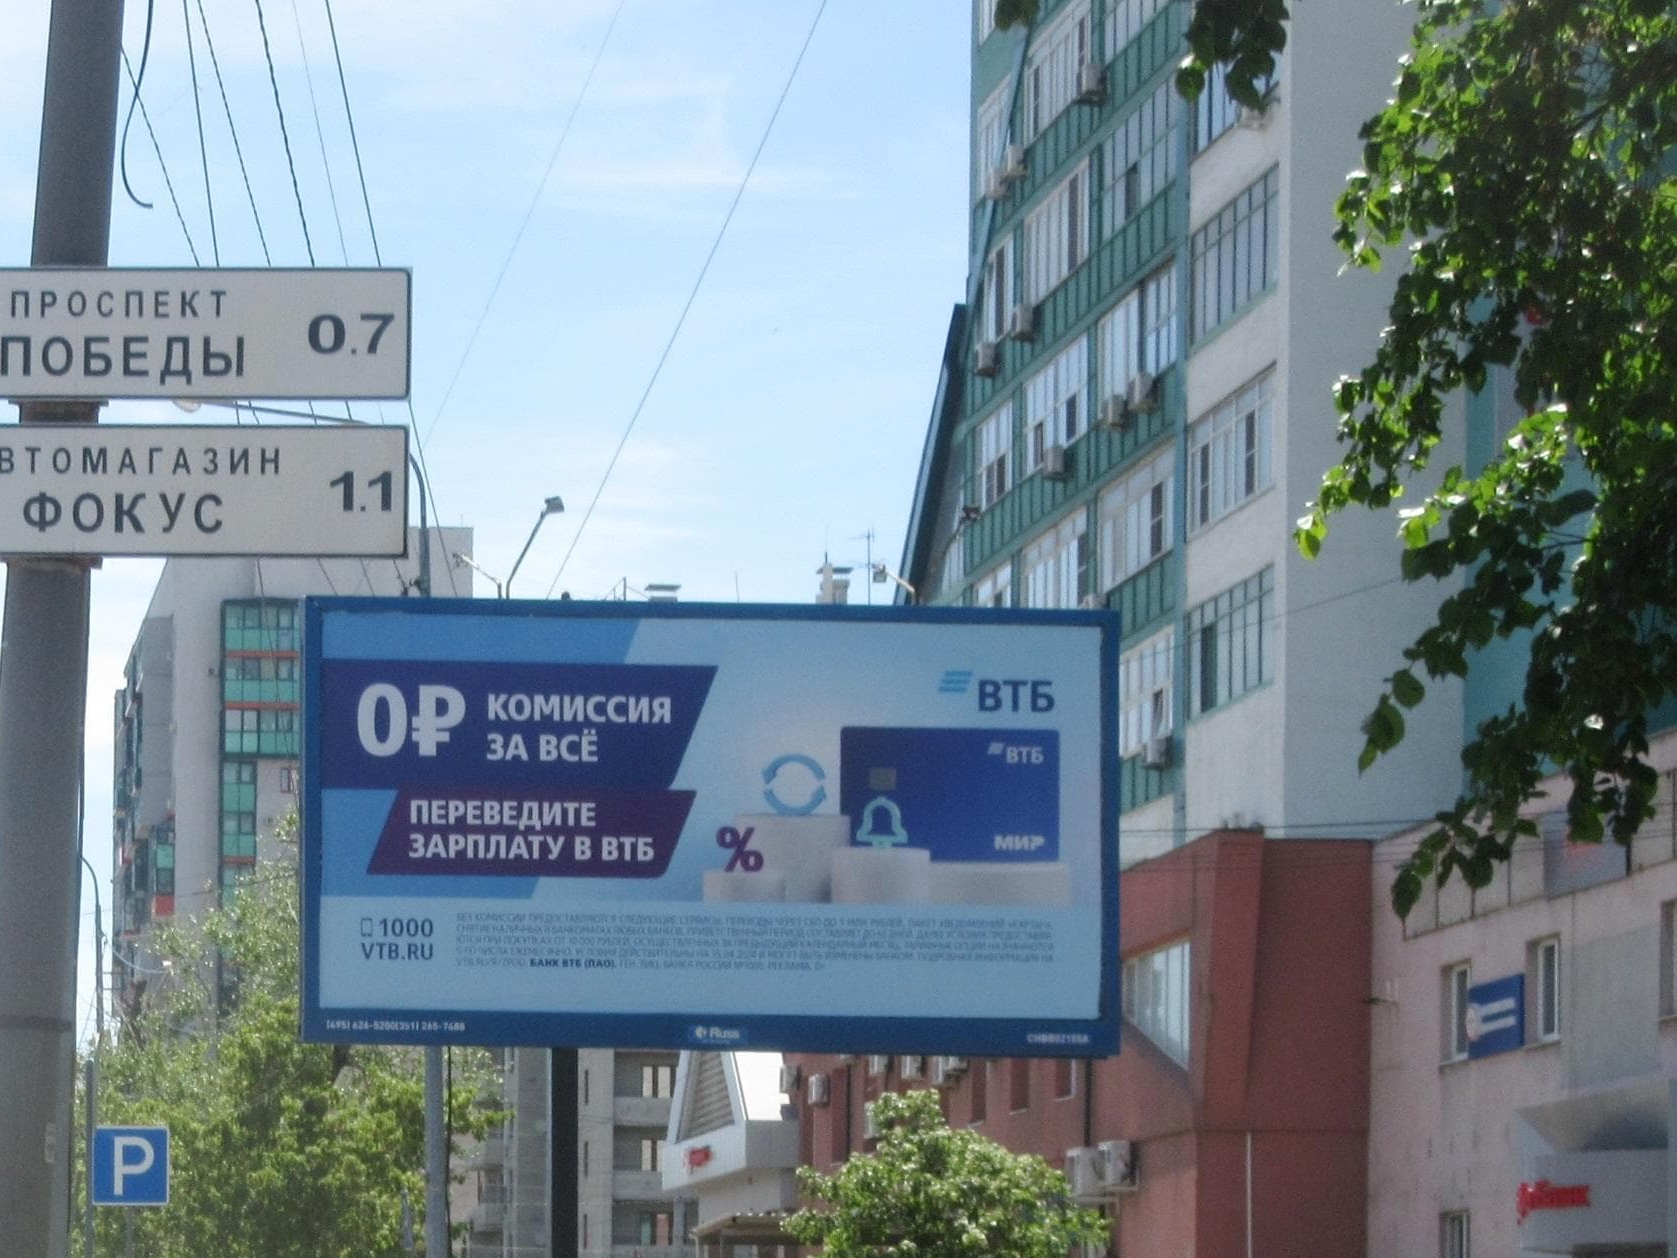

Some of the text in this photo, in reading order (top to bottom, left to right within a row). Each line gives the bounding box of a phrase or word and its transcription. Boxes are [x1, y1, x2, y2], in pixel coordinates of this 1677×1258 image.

[10, 290, 227, 318] ПРОСПЕКТ
[307, 313, 395, 355] 0.7
[0, 336, 245, 385] ПОБЕДЫ
[329, 470, 393, 511] 1.1
[23, 492, 224, 534] ФОКУС
[487, 694, 672, 724] КОМИССИЯ
[978, 679, 1055, 713] ВТБ
[486, 728, 599, 762] ЗА ВСЁ
[1006, 746, 1044, 763] ВТБ
[410, 799, 596, 830] ПЕРЕВЕДИТЕ
[408, 833, 655, 862] ЗАРПЛАТУ В ВТБ
[994, 834, 1045, 851] МИР
[379, 918, 434, 937] 1000
[361, 942, 434, 961] VTB.RU
[530, 958, 558, 967] БАНК
[562, 958, 581, 968] ВТБ
[113, 1136, 155, 1196] P
